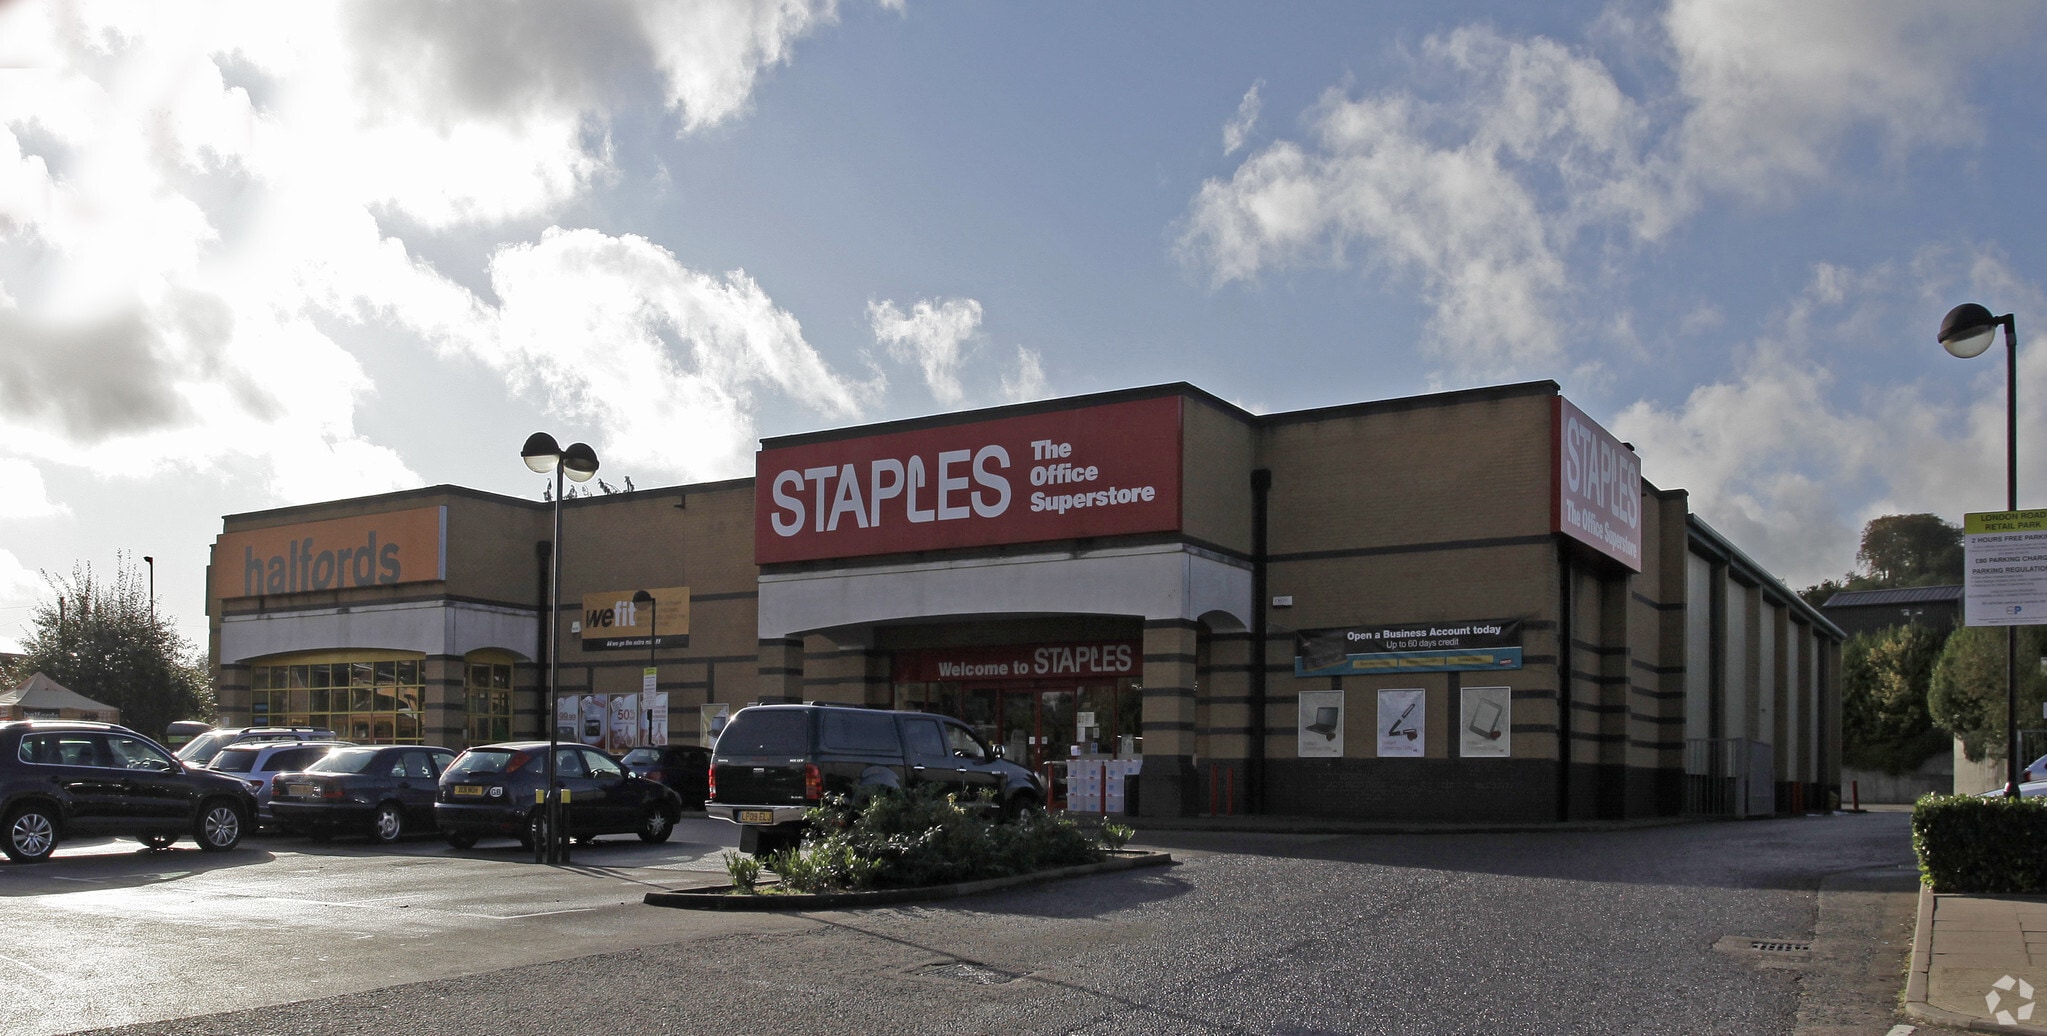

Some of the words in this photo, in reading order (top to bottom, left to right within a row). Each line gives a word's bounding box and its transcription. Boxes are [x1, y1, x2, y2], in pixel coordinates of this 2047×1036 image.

[1030, 439, 1072, 461] The
[1030, 463, 1099, 486] Office
[1567, 416, 1637, 529] STAPLES
[770, 444, 1012, 537] STAPLES
[1030, 486, 1156, 514] Superstore
[1980, 513, 2018, 522] LONDON
[2020, 511, 2046, 519] ROAD
[1985, 522, 2015, 531] RETAIL
[2017, 521, 2041, 529] PARK
[1566, 499, 1581, 528] The
[1582, 508, 1604, 540] Office
[1604, 521, 1637, 558] Superstore
[2004, 534, 2023, 542] FREE
[244, 530, 400, 597] halfords
[1972, 567, 2004, 575] PARKING
[1346, 630, 1373, 642] Open
[1383, 628, 1427, 639] Business
[1429, 626, 1471, 637] Account
[1473, 625, 1502, 636] today
[1386, 641, 1398, 649] Up
[1399, 640, 1407, 648] to
[1408, 639, 1418, 648] 60
[1419, 638, 1437, 648] days
[1438, 637, 1459, 646] credit
[938, 662, 1008, 677] Welcome
[1013, 660, 1029, 675] to
[1033, 645, 1132, 674] STAPLES
[491, 788, 501, 796] GB
